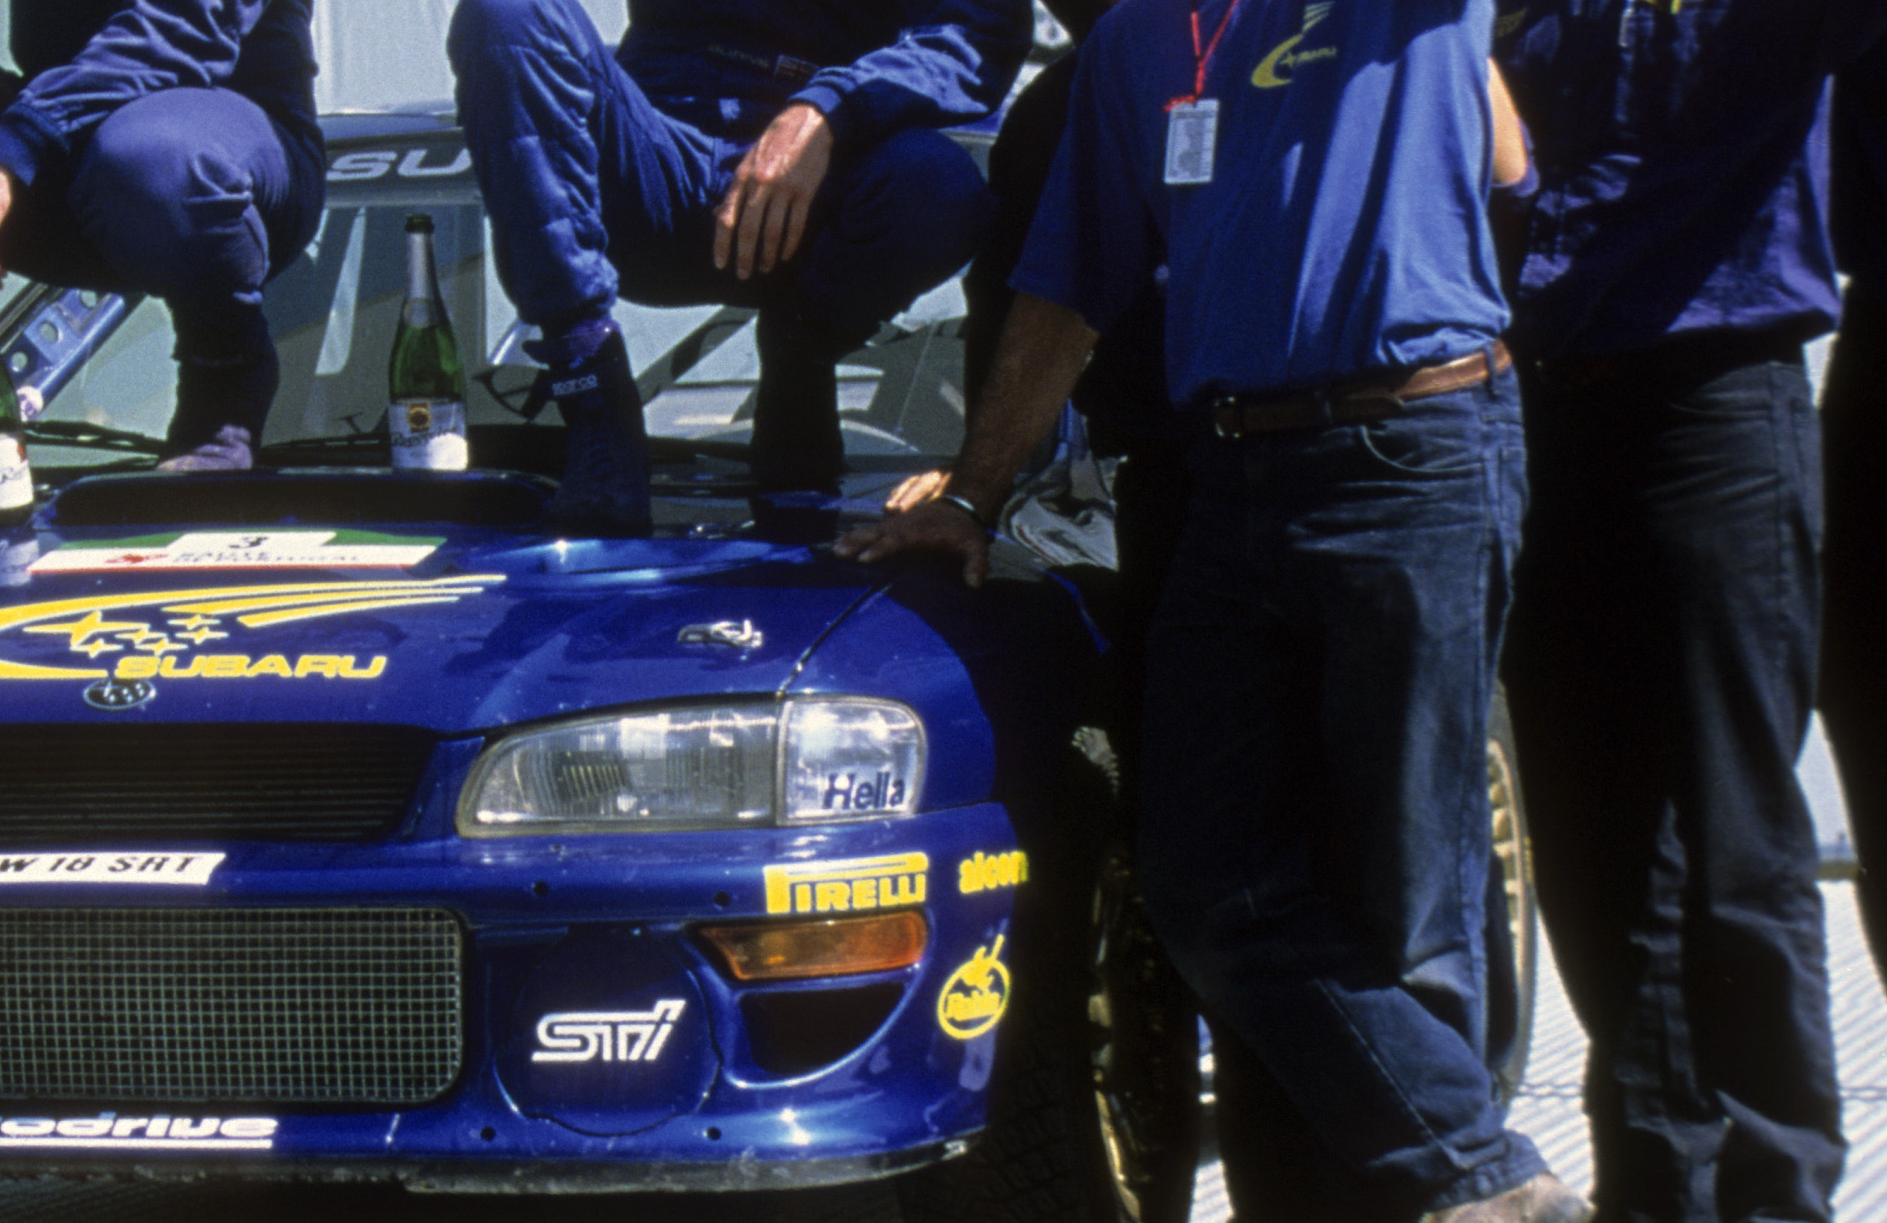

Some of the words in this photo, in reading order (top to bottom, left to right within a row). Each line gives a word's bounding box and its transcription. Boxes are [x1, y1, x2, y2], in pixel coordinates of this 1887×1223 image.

[229, 536, 271, 549] 3
[114, 654, 387, 679] SUBARU
[822, 771, 905, 811] Hella
[763, 852, 929, 914] PIRELLI
[959, 851, 1028, 894] alcon
